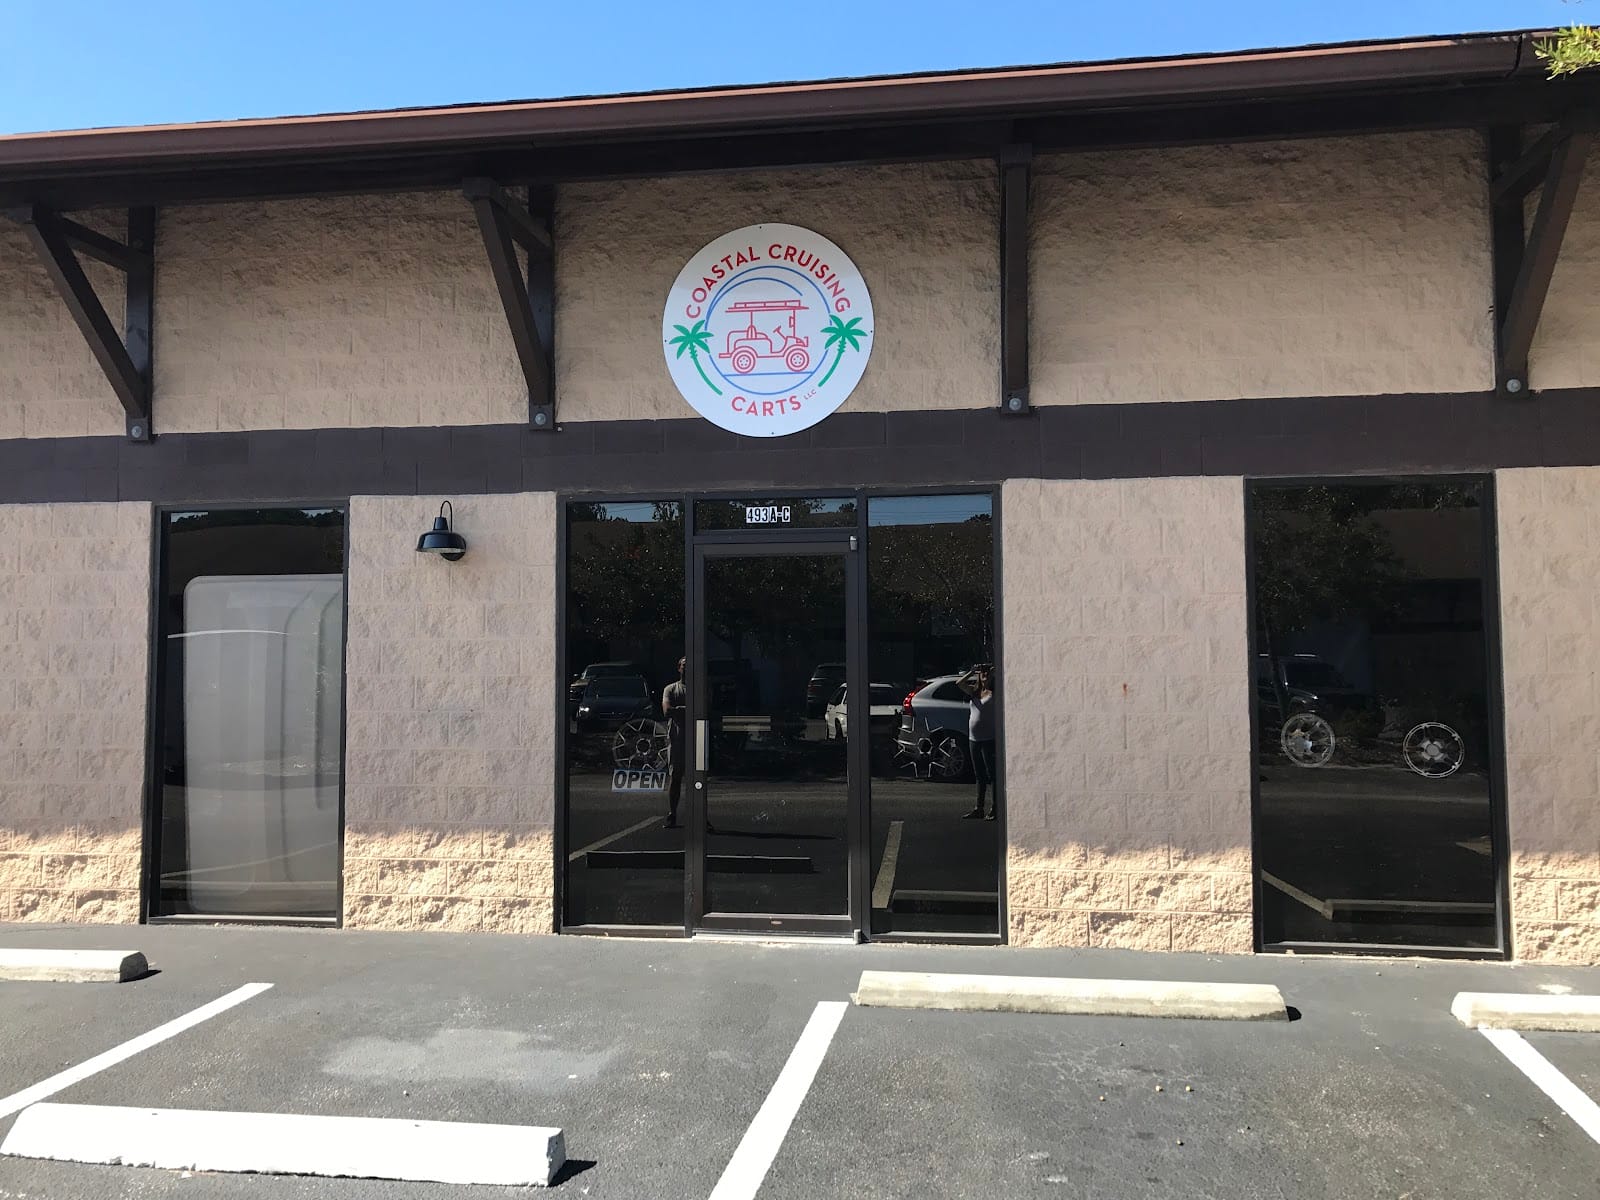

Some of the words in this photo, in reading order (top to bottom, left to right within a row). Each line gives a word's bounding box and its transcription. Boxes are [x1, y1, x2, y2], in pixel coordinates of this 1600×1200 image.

[686, 246, 760, 319] COASTAL
[768, 243, 851, 313] CRUISING
[731, 395, 801, 417] CARTS
[803, 389, 817, 400] LLC
[613, 770, 665, 789] OPEN
